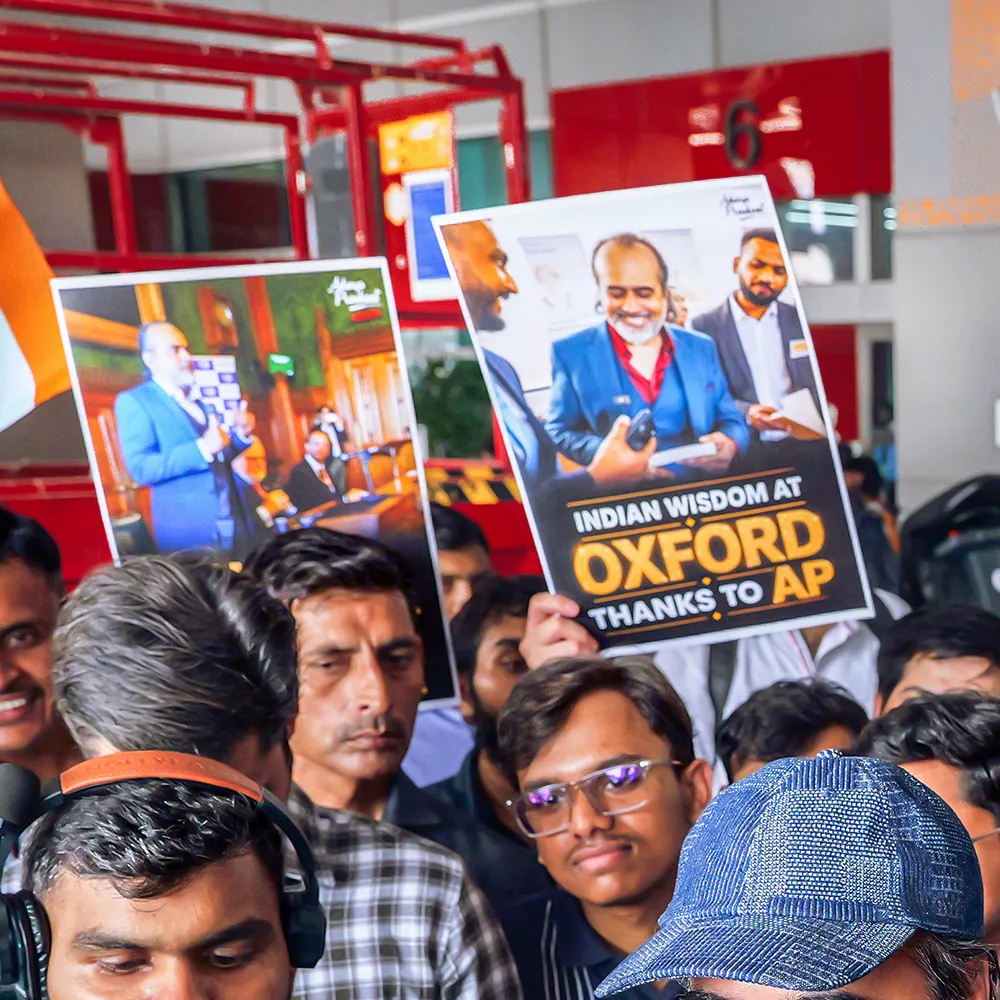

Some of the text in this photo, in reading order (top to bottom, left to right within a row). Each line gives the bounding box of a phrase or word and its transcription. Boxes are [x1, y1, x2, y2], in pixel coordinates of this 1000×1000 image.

[726, 98, 762, 170] 6
[572, 475, 803, 533] INDIAN WISDOM AT
[572, 508, 826, 596] OXFORD
[588, 558, 835, 630] THANKS TO AP
